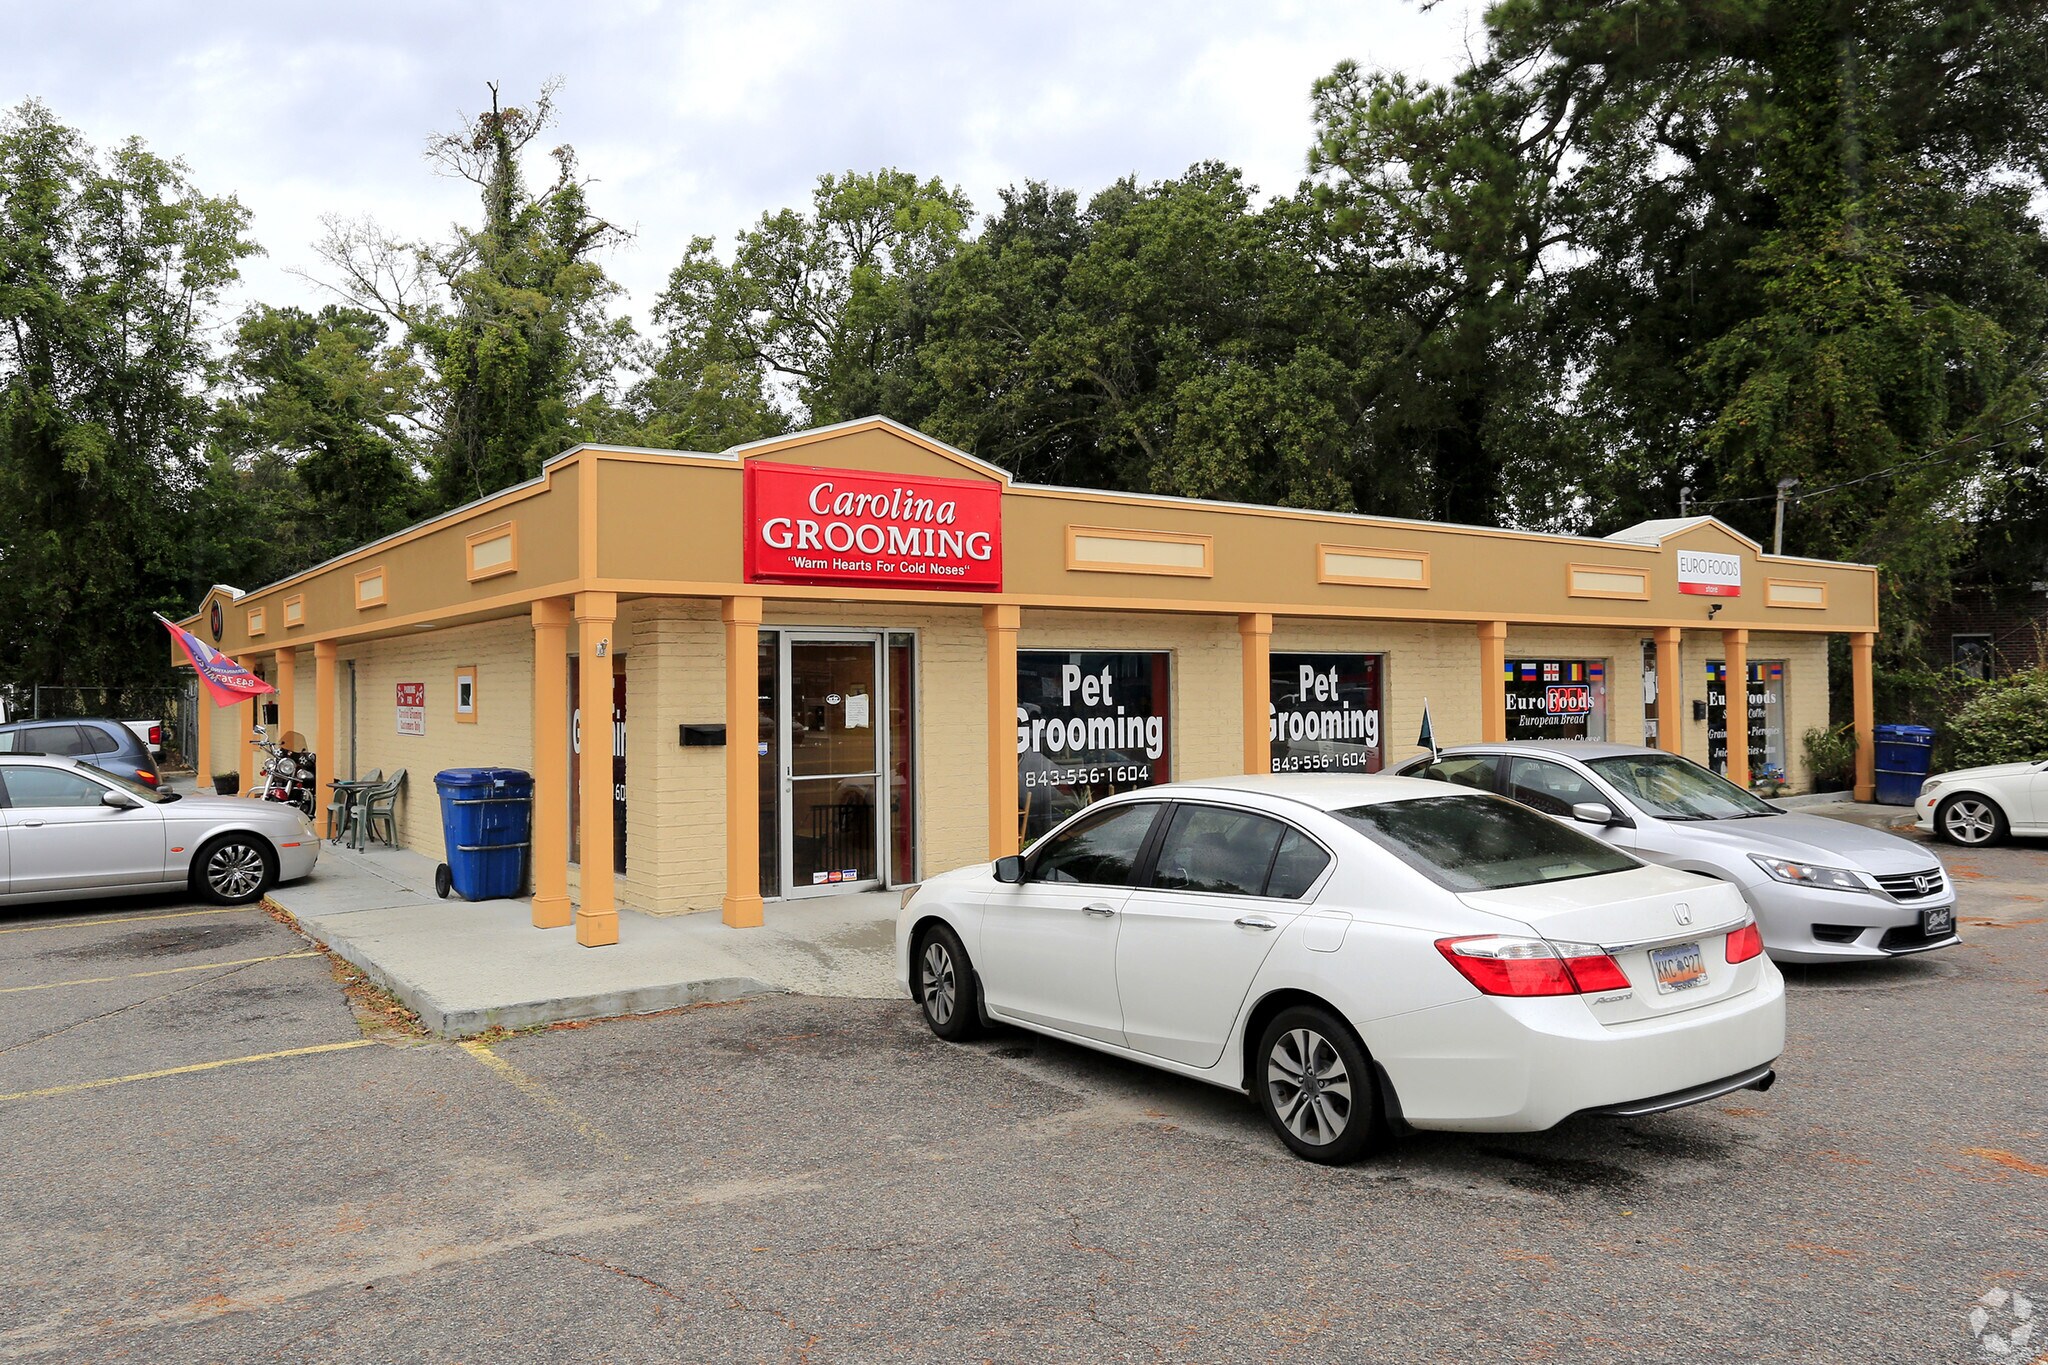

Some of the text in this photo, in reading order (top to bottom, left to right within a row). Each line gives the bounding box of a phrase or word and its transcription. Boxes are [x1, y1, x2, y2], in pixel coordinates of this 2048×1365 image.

[808, 482, 956, 525] Carolina
[762, 518, 992, 560] GROOMING
[833, 558, 872, 571] Hearts
[876, 560, 895, 573] For
[900, 561, 926, 574] Cold
[1062, 664, 1113, 707] Pet
[1299, 664, 1339, 702] Pet
[1746, 690, 1777, 704] oods
[1519, 714, 1585, 728] European Bread
[1272, 752, 1367, 773] 843-556-1604
[1025, 765, 1149, 788] 843-556-1604
[1655, 953, 1702, 981] KKC 927
